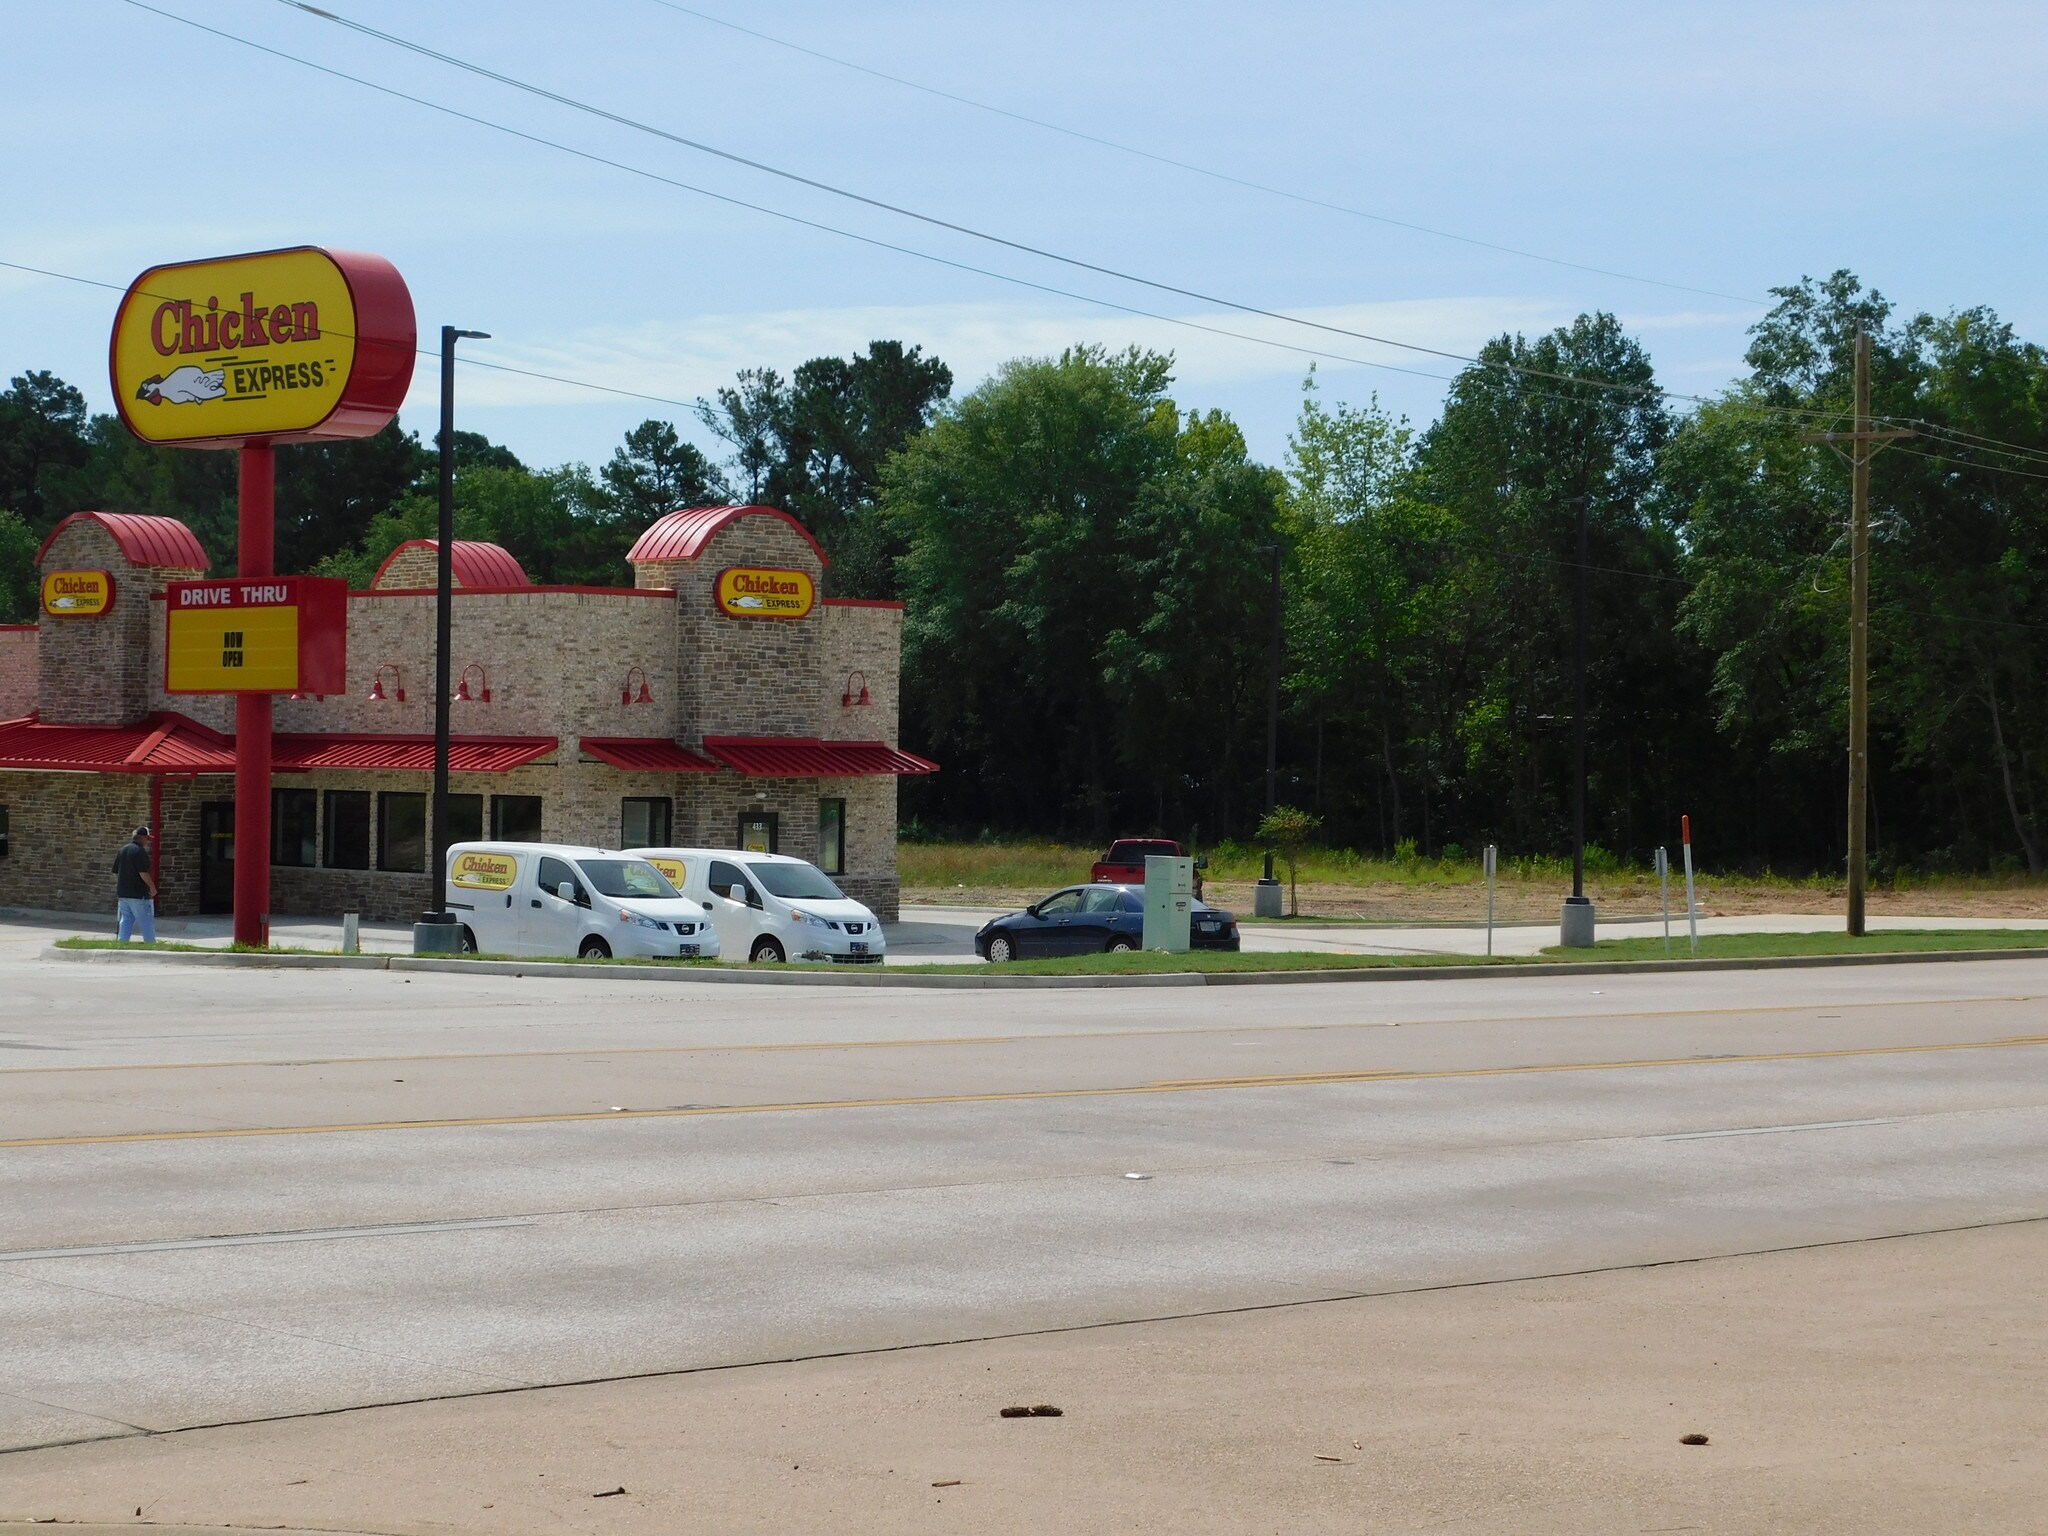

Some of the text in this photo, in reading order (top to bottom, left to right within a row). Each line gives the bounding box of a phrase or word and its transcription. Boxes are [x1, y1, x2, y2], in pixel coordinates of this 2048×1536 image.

[151, 292, 321, 356] Chicken
[234, 361, 324, 393] EXPRESS
[54, 576, 100, 594] Chicken
[732, 574, 800, 595] Chicken
[75, 598, 100, 607] EXPRESS
[180, 585, 287, 606] DRIVE THRU
[766, 599, 800, 609] EXPRESS
[224, 632, 243, 648] NOW
[222, 651, 243, 667] OPEN
[752, 822, 763, 831] 433
[462, 856, 508, 874] Chicken
[482, 876, 507, 885] EXPRESS
